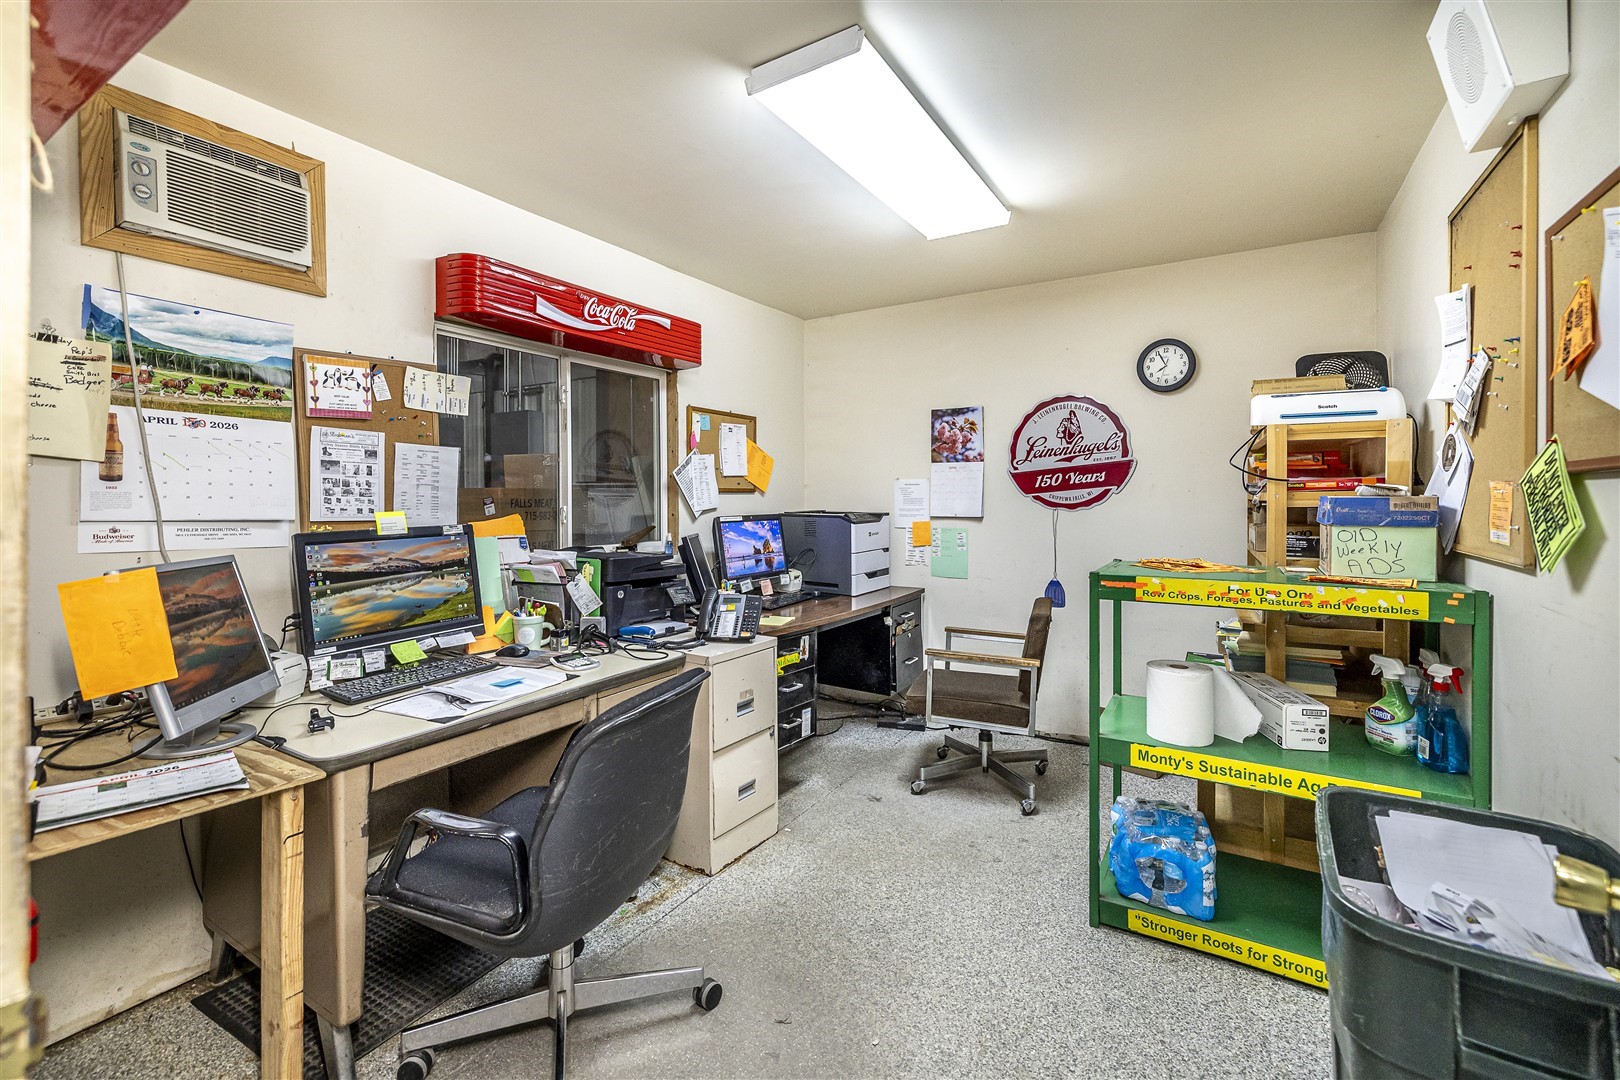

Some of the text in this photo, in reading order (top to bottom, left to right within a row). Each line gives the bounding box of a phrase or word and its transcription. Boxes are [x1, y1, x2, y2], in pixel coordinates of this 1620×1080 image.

[64, 375, 105, 390] Badger
[1038, 403, 1073, 420] LEINENKUGEL
[1074, 403, 1099, 417] BREWING
[1098, 414, 1107, 424] CO.
[210, 421, 238, 430] 2026
[1016, 432, 1120, 465] Leinenkugel's
[1035, 471, 1106, 488] 150 Years
[1544, 449, 1569, 534] DO NOT ENTER
[511, 499, 532, 508] FALLS
[534, 499, 552, 507] MEAT
[1533, 468, 1557, 542] AUTHORIZED
[1524, 473, 1551, 562] PERSONAL ONLY
[1348, 557, 1405, 575] ADS
[1228, 585, 1250, 595] For
[1255, 587, 1282, 597] Use
[1142, 589, 1420, 616] Row Crops, Forages, Pastures and Vegetables
[1369, 708, 1391, 720] CLOROX
[1137, 748, 1321, 796] Monty's Sustainable Ag
[1202, 933, 1243, 955] Roots
[1248, 947, 1268, 962] for
